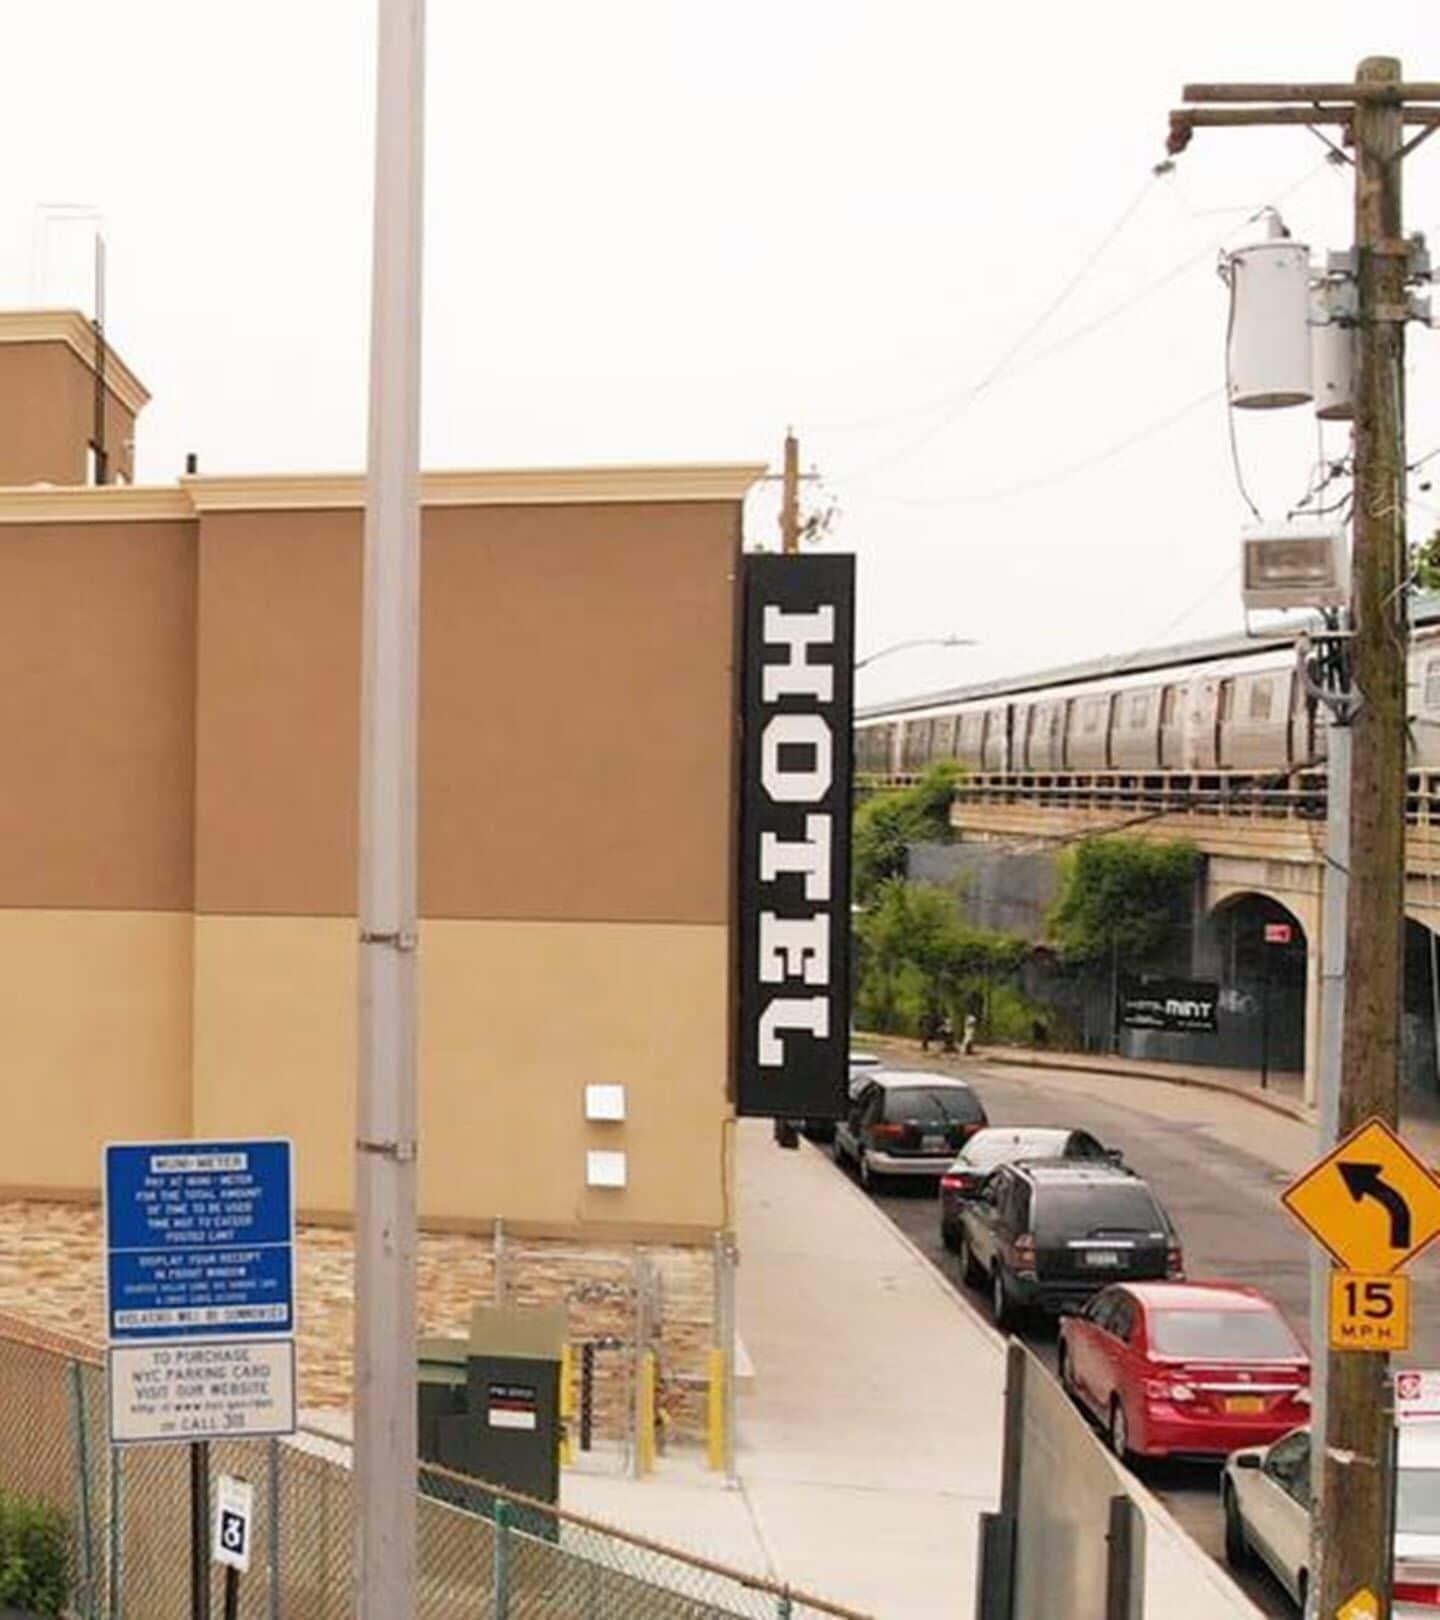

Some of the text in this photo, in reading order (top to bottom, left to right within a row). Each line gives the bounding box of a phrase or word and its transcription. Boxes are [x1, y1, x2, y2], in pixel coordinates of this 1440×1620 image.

[758, 604, 834, 1067] HOTEL
[161, 1190, 179, 1200] THE
[192, 1203, 205, 1214] TO
[1344, 1281, 1394, 1319] 15
[153, 1350, 250, 1365] TO PURCHASE
[133, 1365, 271, 1382] NYC PARKING CARD
[136, 1382, 270, 1399] VISIT OUR WEBSITE
[181, 1417, 217, 1430] CALL
